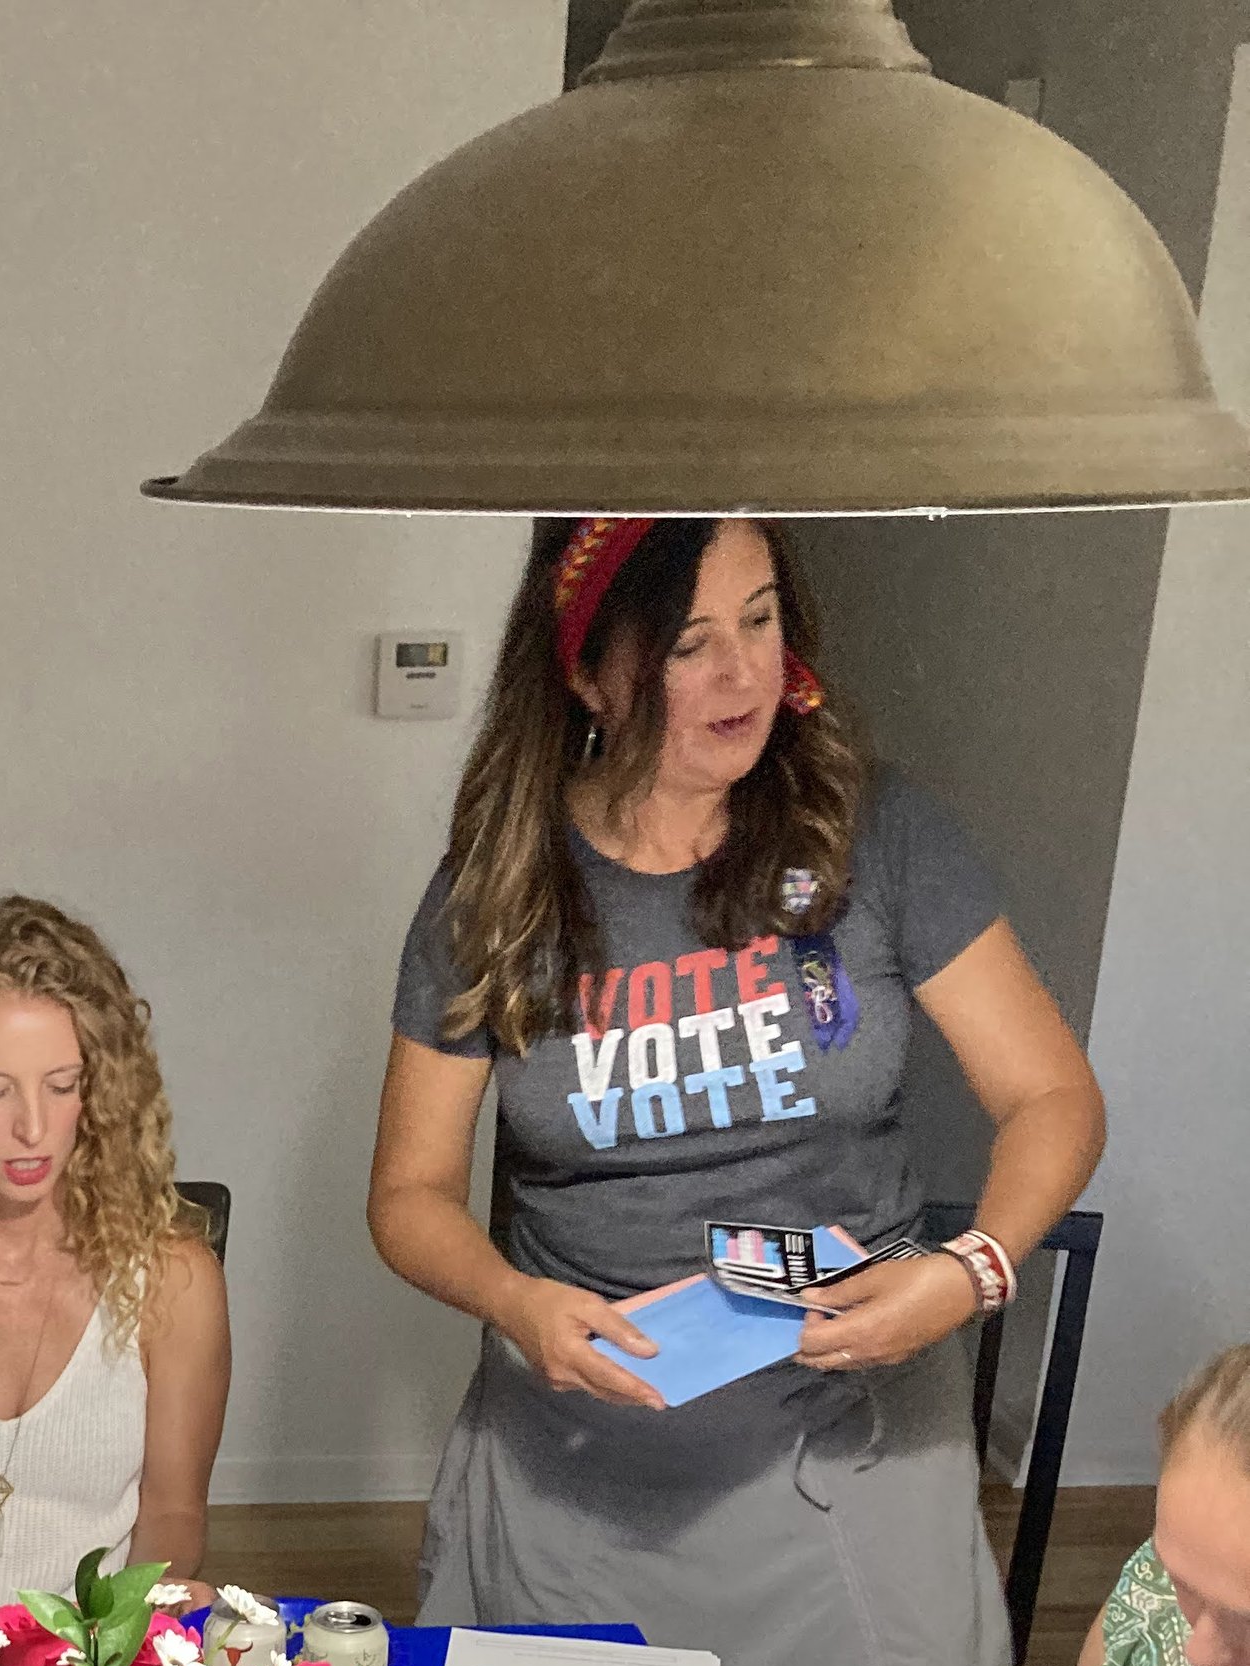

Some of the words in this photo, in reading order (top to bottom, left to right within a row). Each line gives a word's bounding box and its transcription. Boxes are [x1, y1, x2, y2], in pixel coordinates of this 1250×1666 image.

[578, 933, 786, 1039] VOTE
[567, 1048, 816, 1149] VOTE
[572, 993, 803, 1101] VOTE
